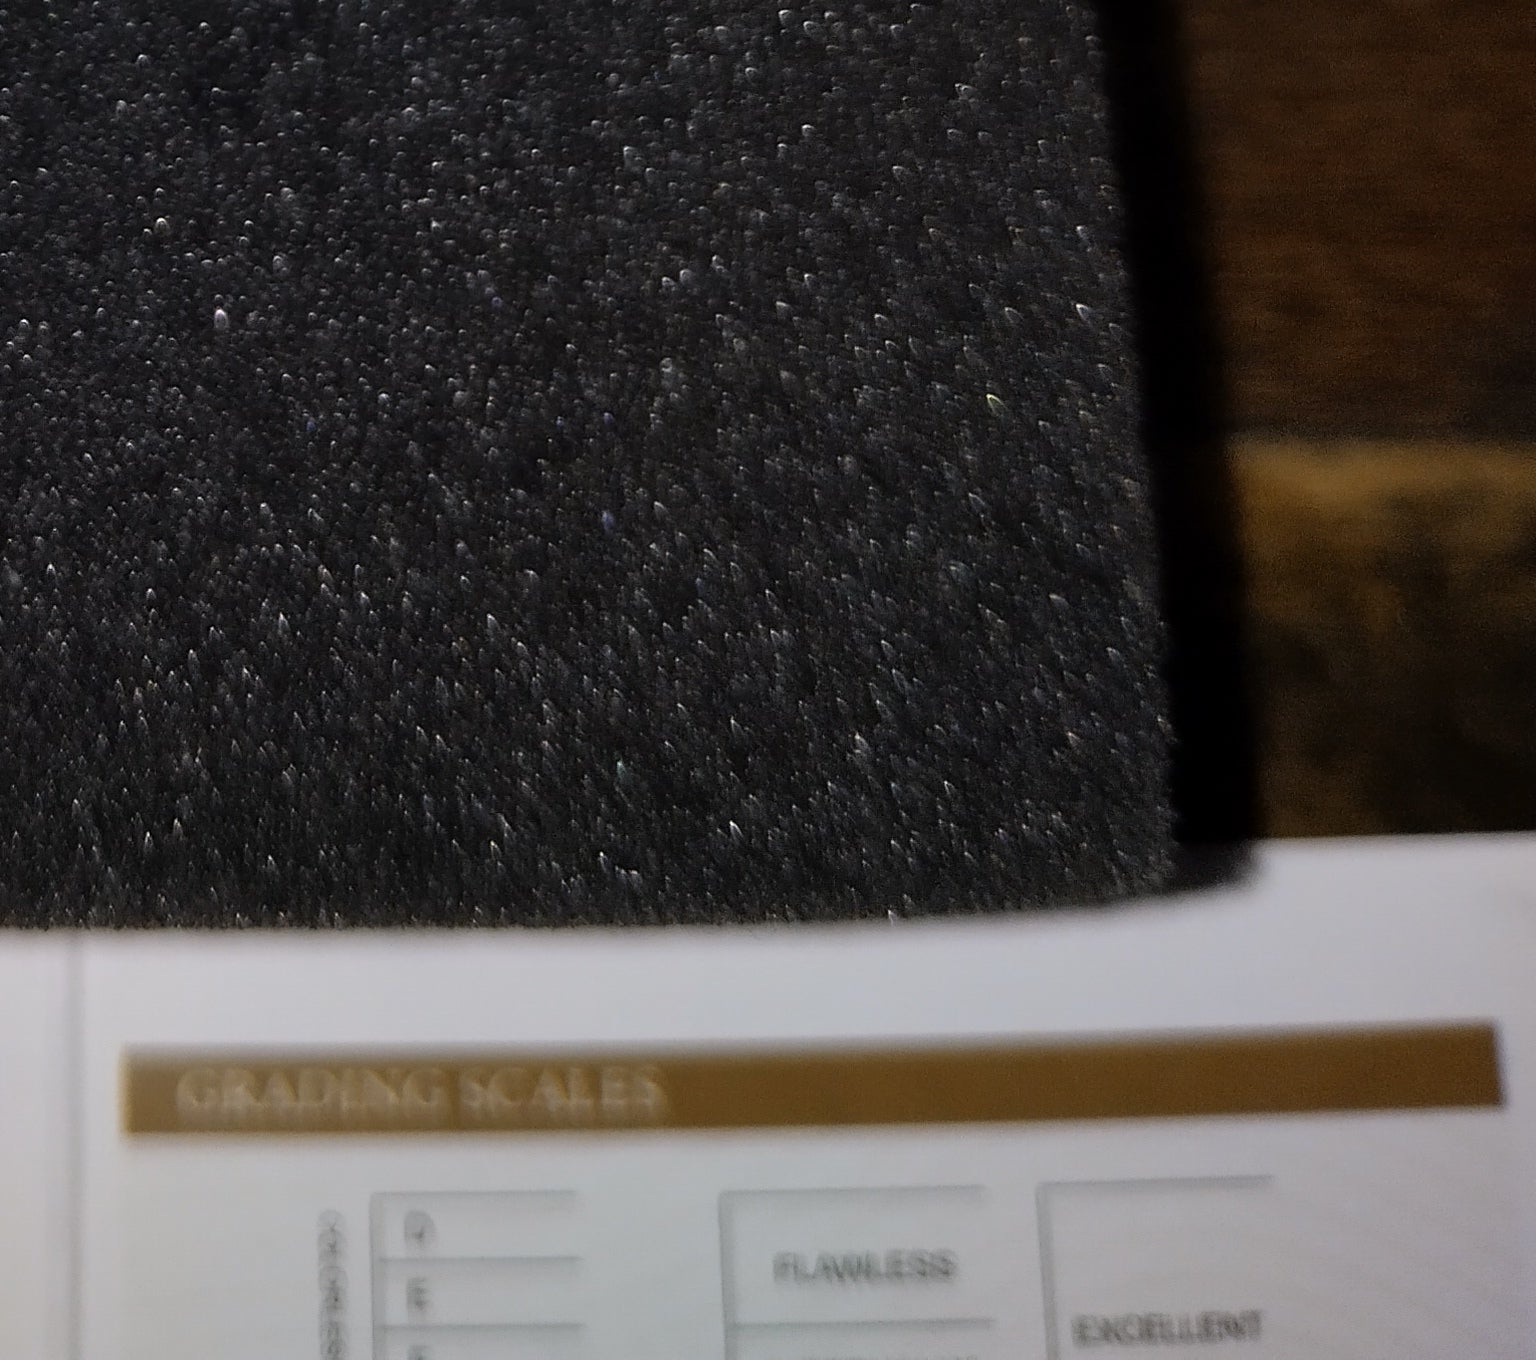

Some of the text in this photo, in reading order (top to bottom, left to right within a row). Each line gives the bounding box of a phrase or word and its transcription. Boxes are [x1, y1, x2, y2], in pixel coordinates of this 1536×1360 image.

[176, 1062, 668, 1130] GRADING SCALES
[772, 1248, 958, 1283] FLAWLESS
[1071, 1308, 1263, 1347] EXCELLENT
